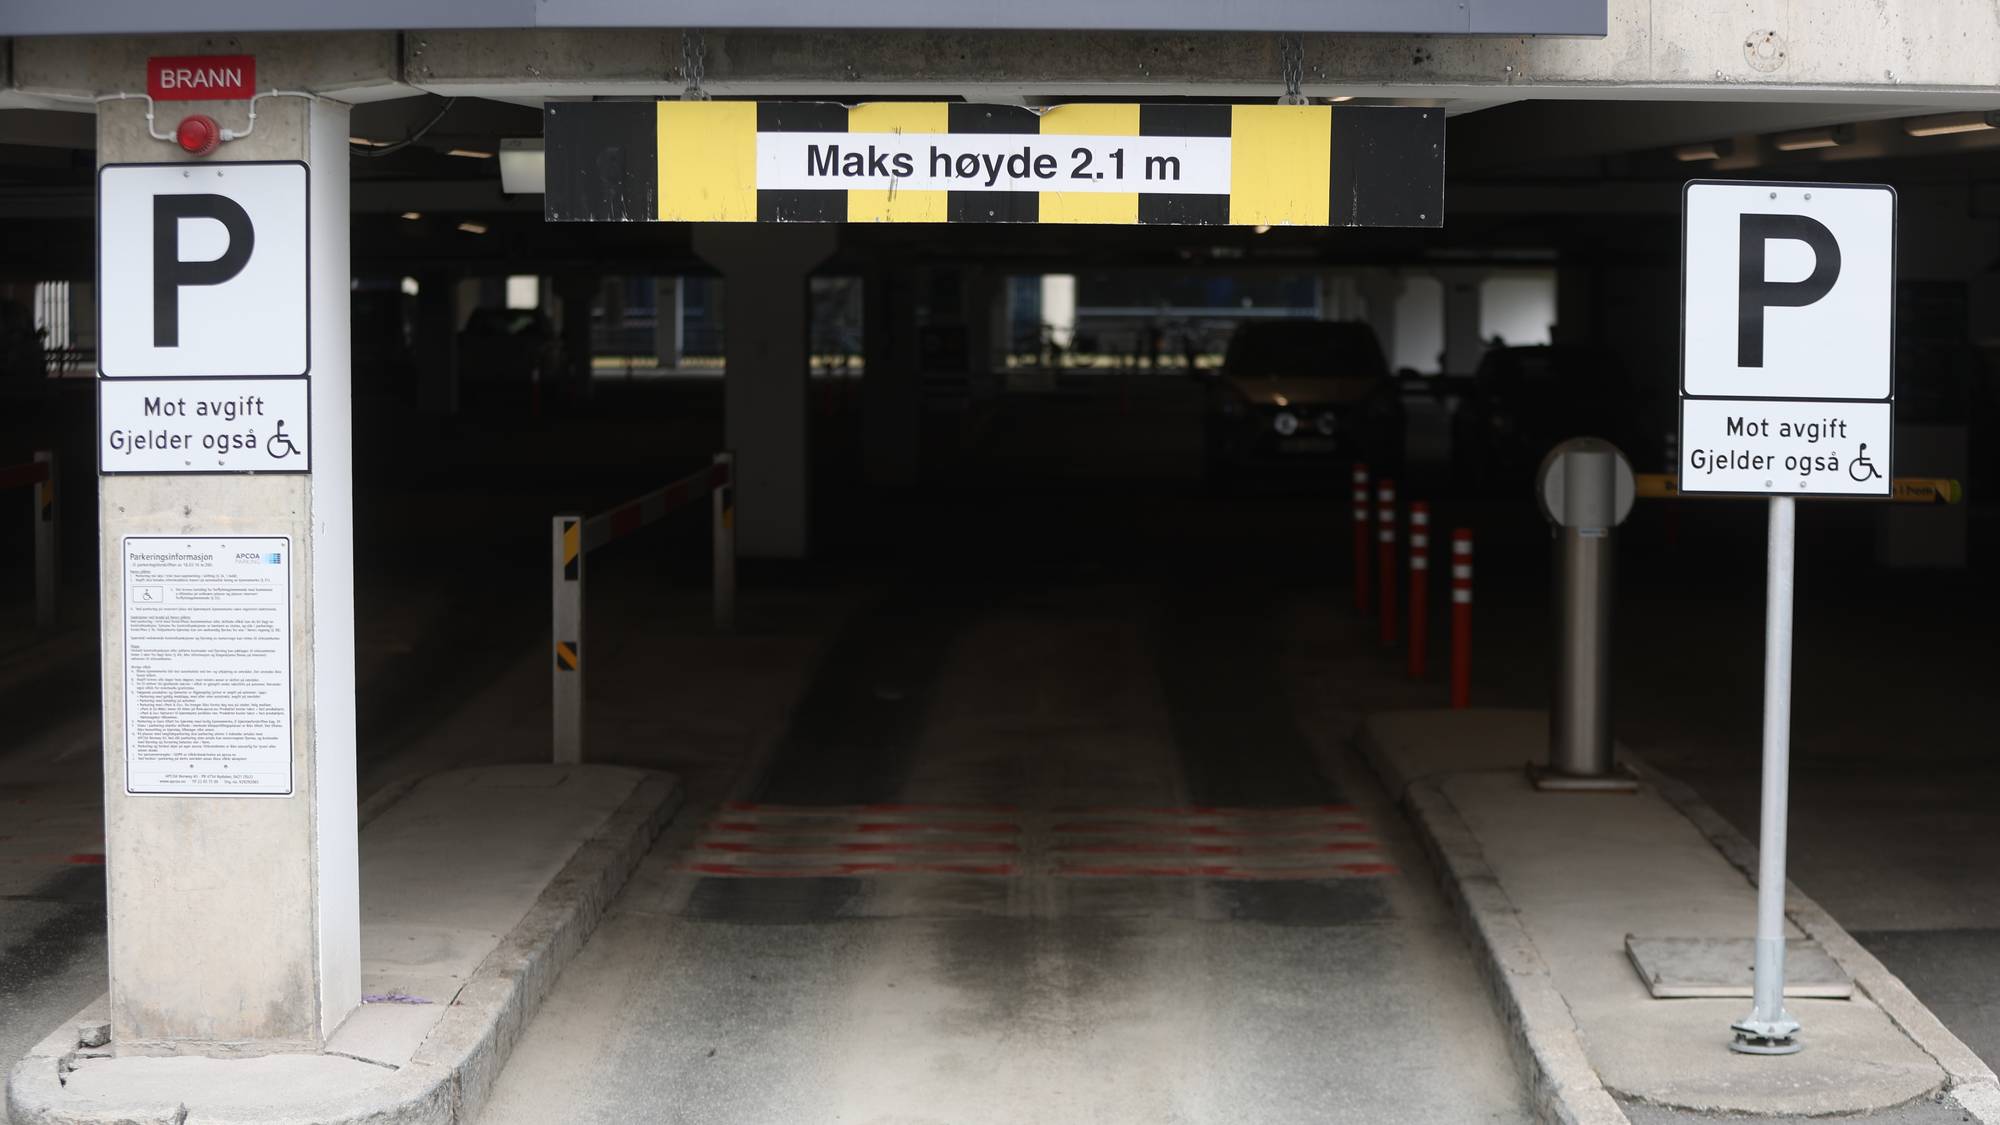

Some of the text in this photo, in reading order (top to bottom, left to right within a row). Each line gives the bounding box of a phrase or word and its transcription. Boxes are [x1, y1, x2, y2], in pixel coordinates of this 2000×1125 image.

[160, 68, 242, 89] BRANN
[806, 144, 1182, 188] Maks høyde 2.1 m
[153, 194, 254, 347] P
[1738, 213, 1841, 367] P
[144, 395, 264, 422] Mot avgift
[109, 428, 257, 456] Gjelder også
[1726, 416, 1847, 443] Mot avgift
[1690, 448, 1839, 477] Gjelder også
[130, 552, 214, 563] Parkeringsinformasjon
[235, 552, 260, 560] APCOA
